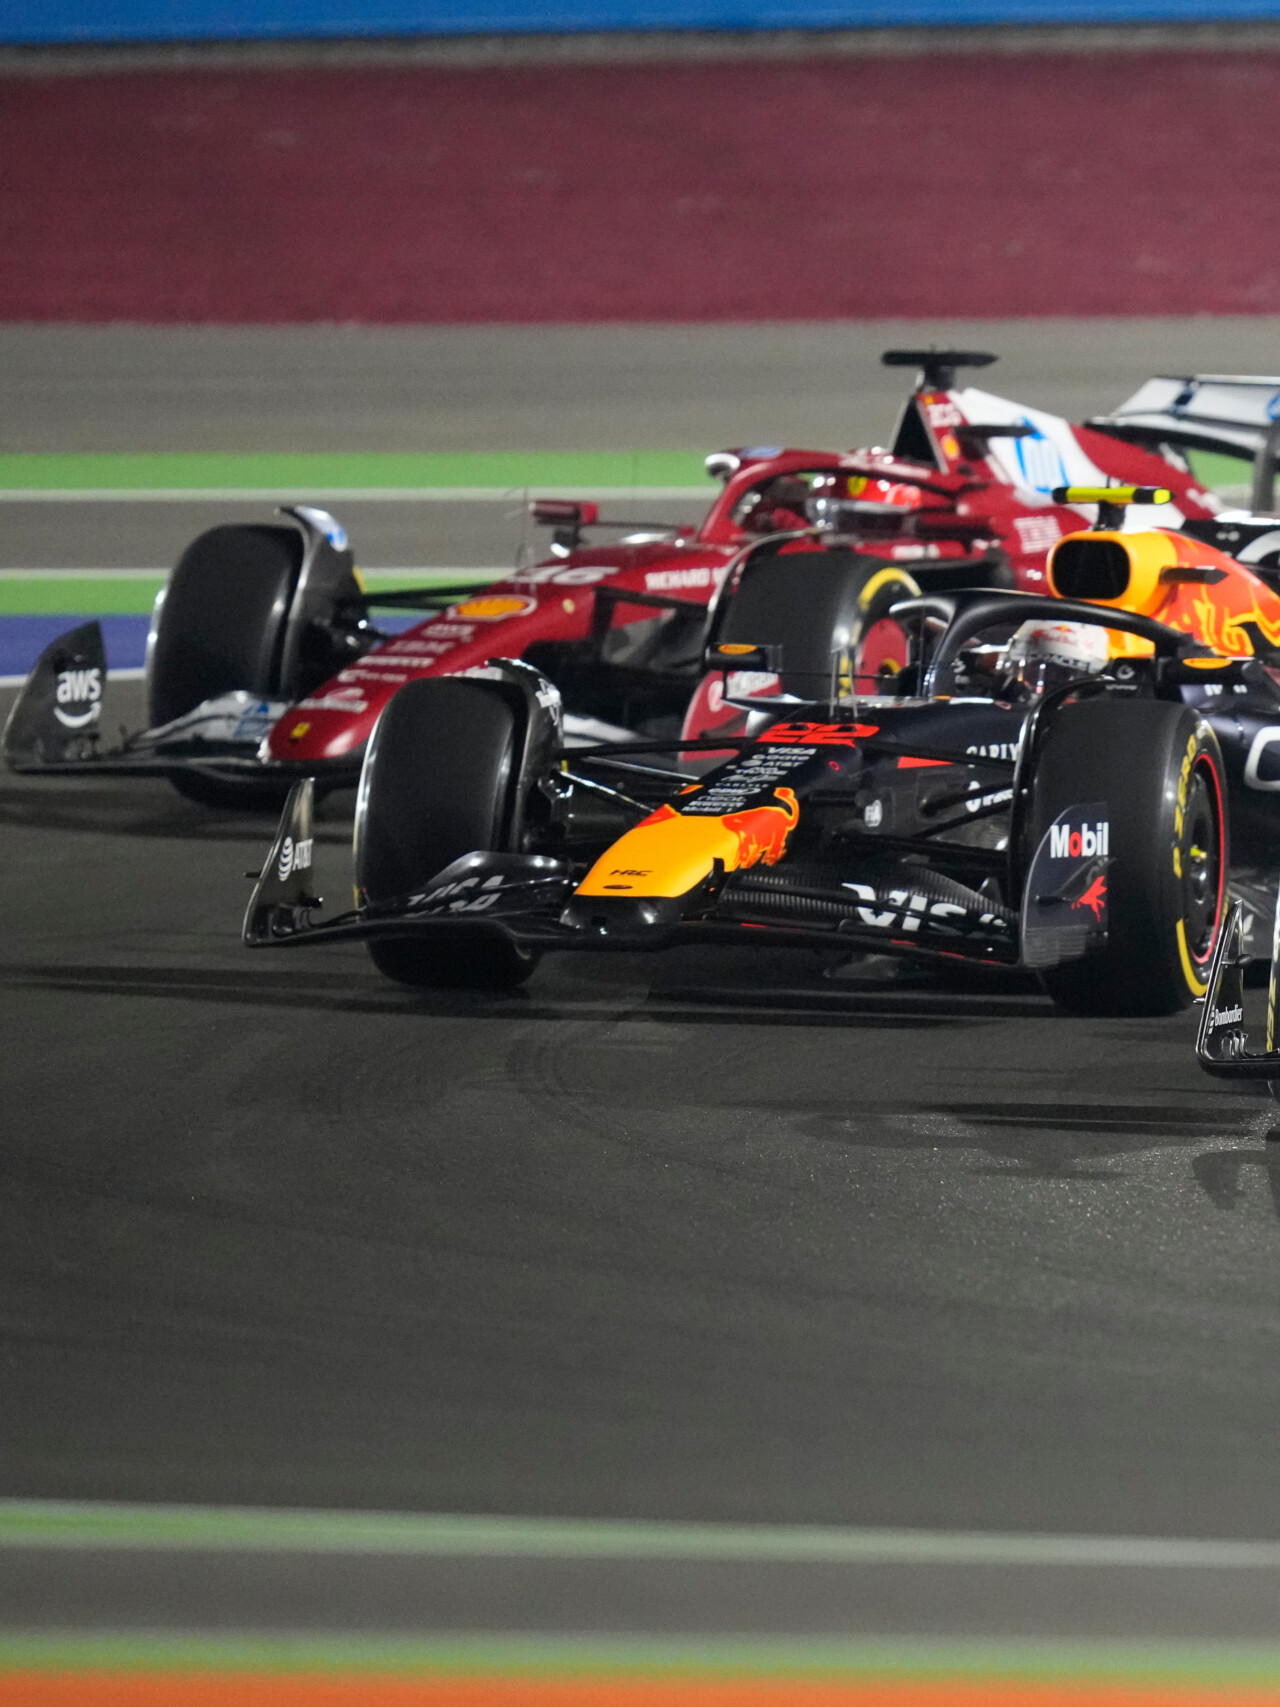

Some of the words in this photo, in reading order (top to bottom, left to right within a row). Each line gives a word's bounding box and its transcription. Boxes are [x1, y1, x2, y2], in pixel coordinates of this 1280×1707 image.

[57, 667, 101, 704] aws
[755, 721, 880, 748] 22
[767, 746, 817, 755] VISA
[1049, 821, 1110, 859] Mobil
[1214, 1004, 1243, 1027] Bombardier
